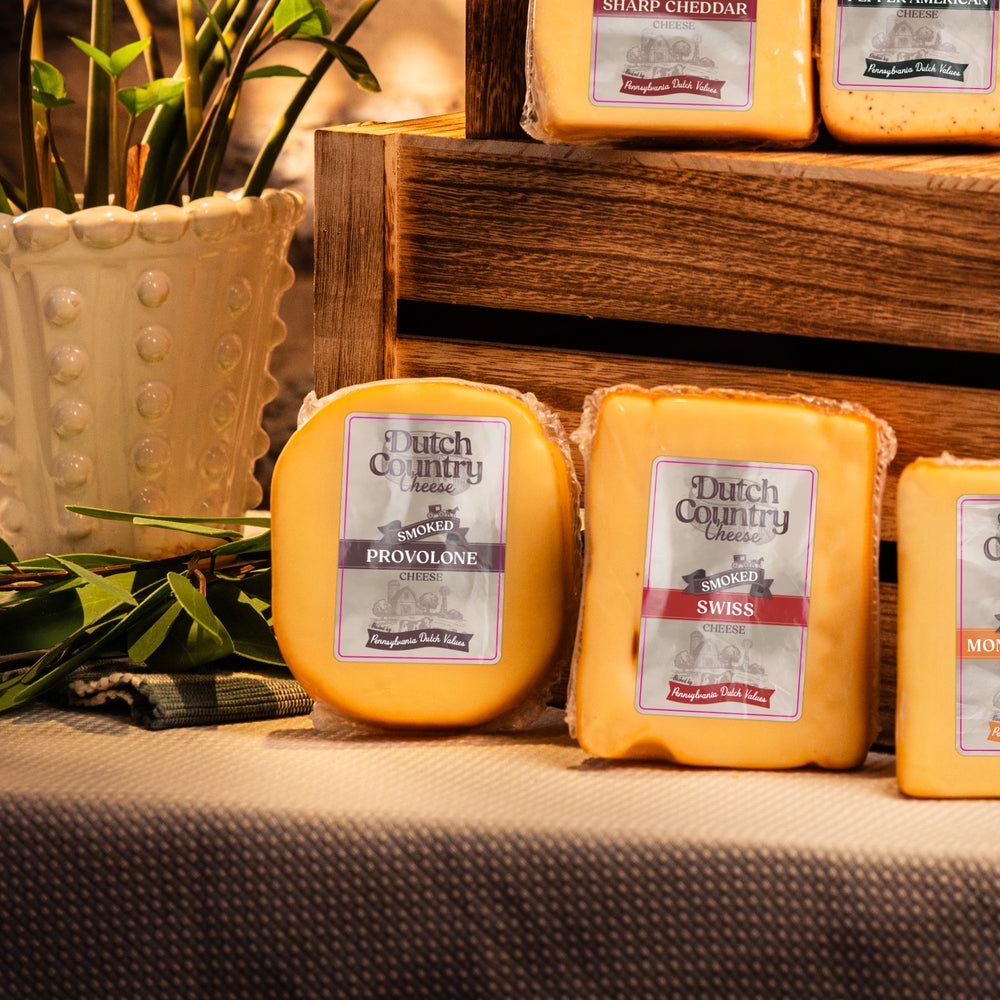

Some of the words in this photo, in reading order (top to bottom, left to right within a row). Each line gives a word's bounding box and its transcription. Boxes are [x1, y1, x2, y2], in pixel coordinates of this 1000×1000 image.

[665, 0, 747, 15] CHEDDAR
[897, 10, 938, 18] CHEESE
[653, 21, 695, 30] CHEESE
[868, 64, 913, 77] Pennsylvania
[915, 62, 936, 72] Dutch
[940, 64, 961, 76] Values
[625, 81, 670, 95] Pennsylvania
[672, 79, 692, 89] Dutch
[696, 81, 718, 93] Values
[385, 430, 472, 455] Dutch
[370, 452, 483, 485] Country
[400, 472, 455, 494] Cheese
[692, 475, 778, 504] Dutch
[676, 499, 789, 535] Country
[398, 520, 454, 542] SMOKED
[705, 519, 760, 543] Cheese
[366, 549, 478, 565] PROVOLONE
[400, 572, 442, 581] CHEESE
[702, 571, 758, 592] SMOKED
[697, 600, 754, 616] SWISS
[703, 624, 745, 634] CHEESE
[371, 634, 417, 648] Pennsylvania
[419, 632, 440, 642] Dutch
[443, 634, 465, 647] Values
[672, 687, 718, 702] Pennsylvania
[720, 686, 742, 698] Dutch
[744, 689, 767, 702] Values
